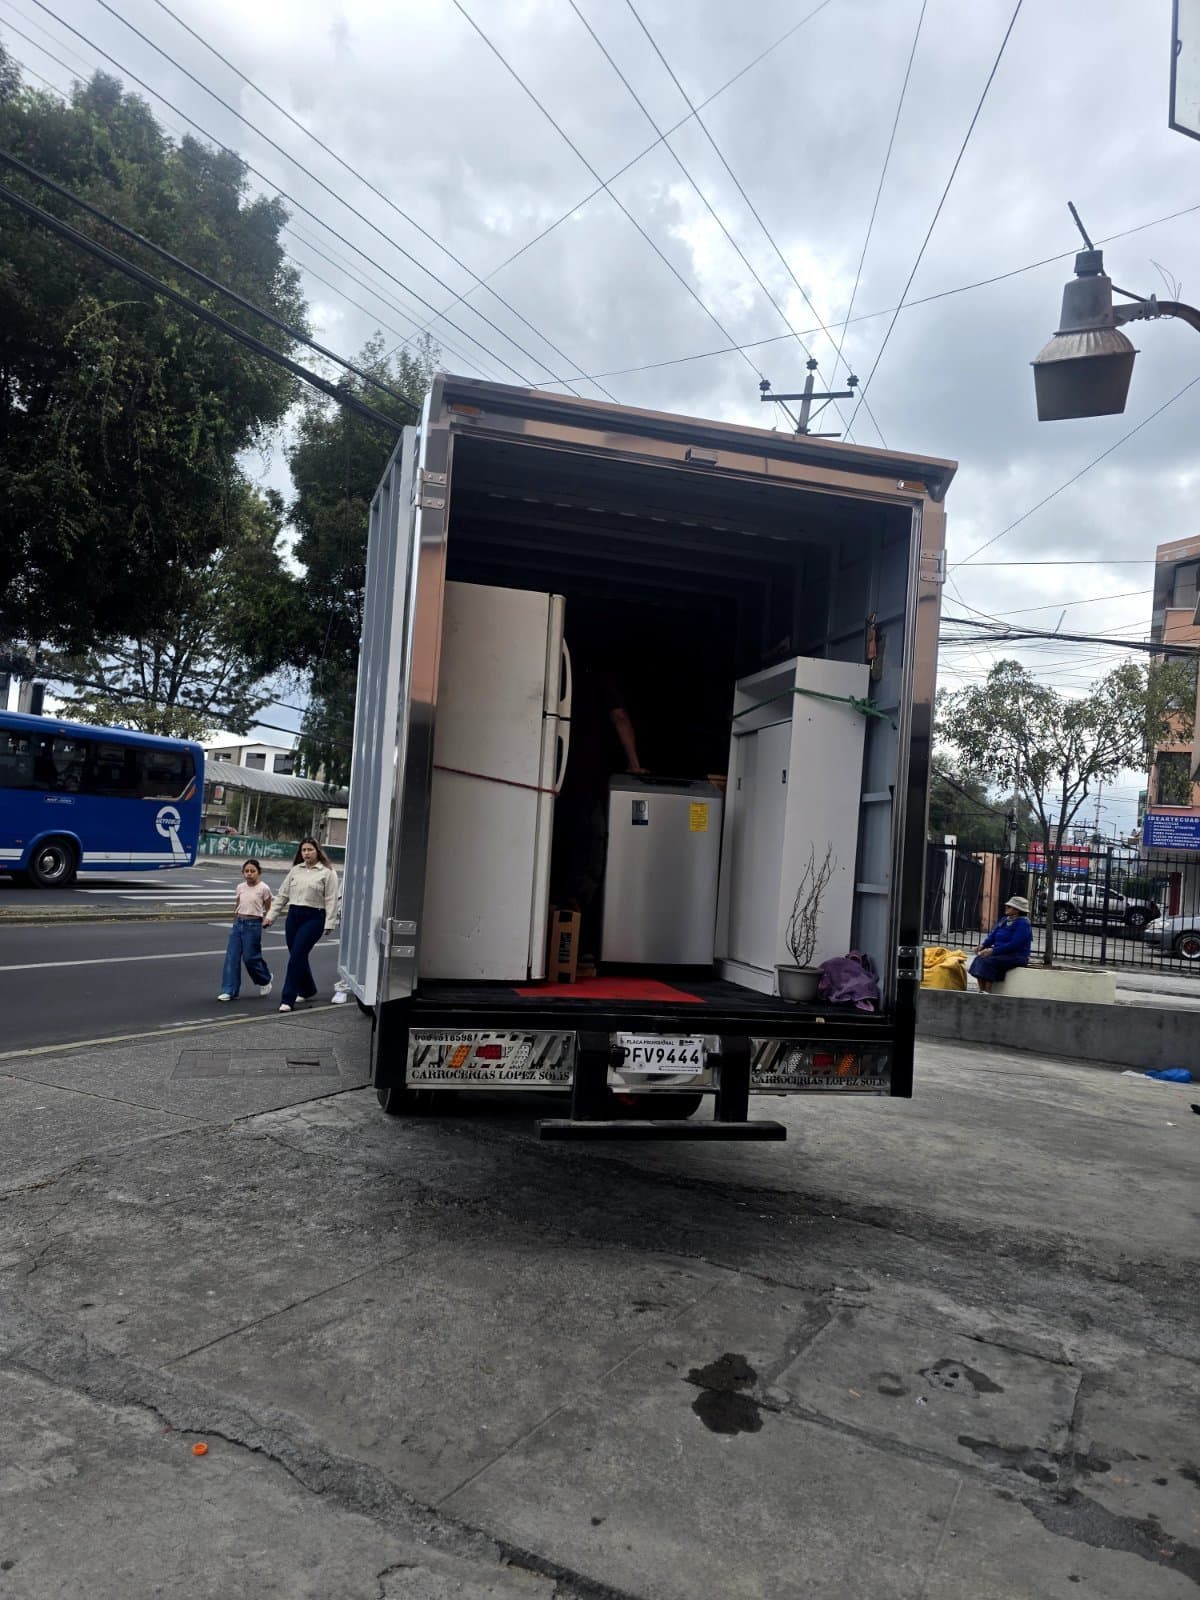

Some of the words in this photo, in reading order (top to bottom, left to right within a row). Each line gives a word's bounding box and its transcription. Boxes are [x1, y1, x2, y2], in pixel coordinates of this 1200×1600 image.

[623, 1047, 699, 1064] PFV9444
[411, 1069, 496, 1081] CARROCERIAS
[498, 1070, 537, 1081] LOPEZ
